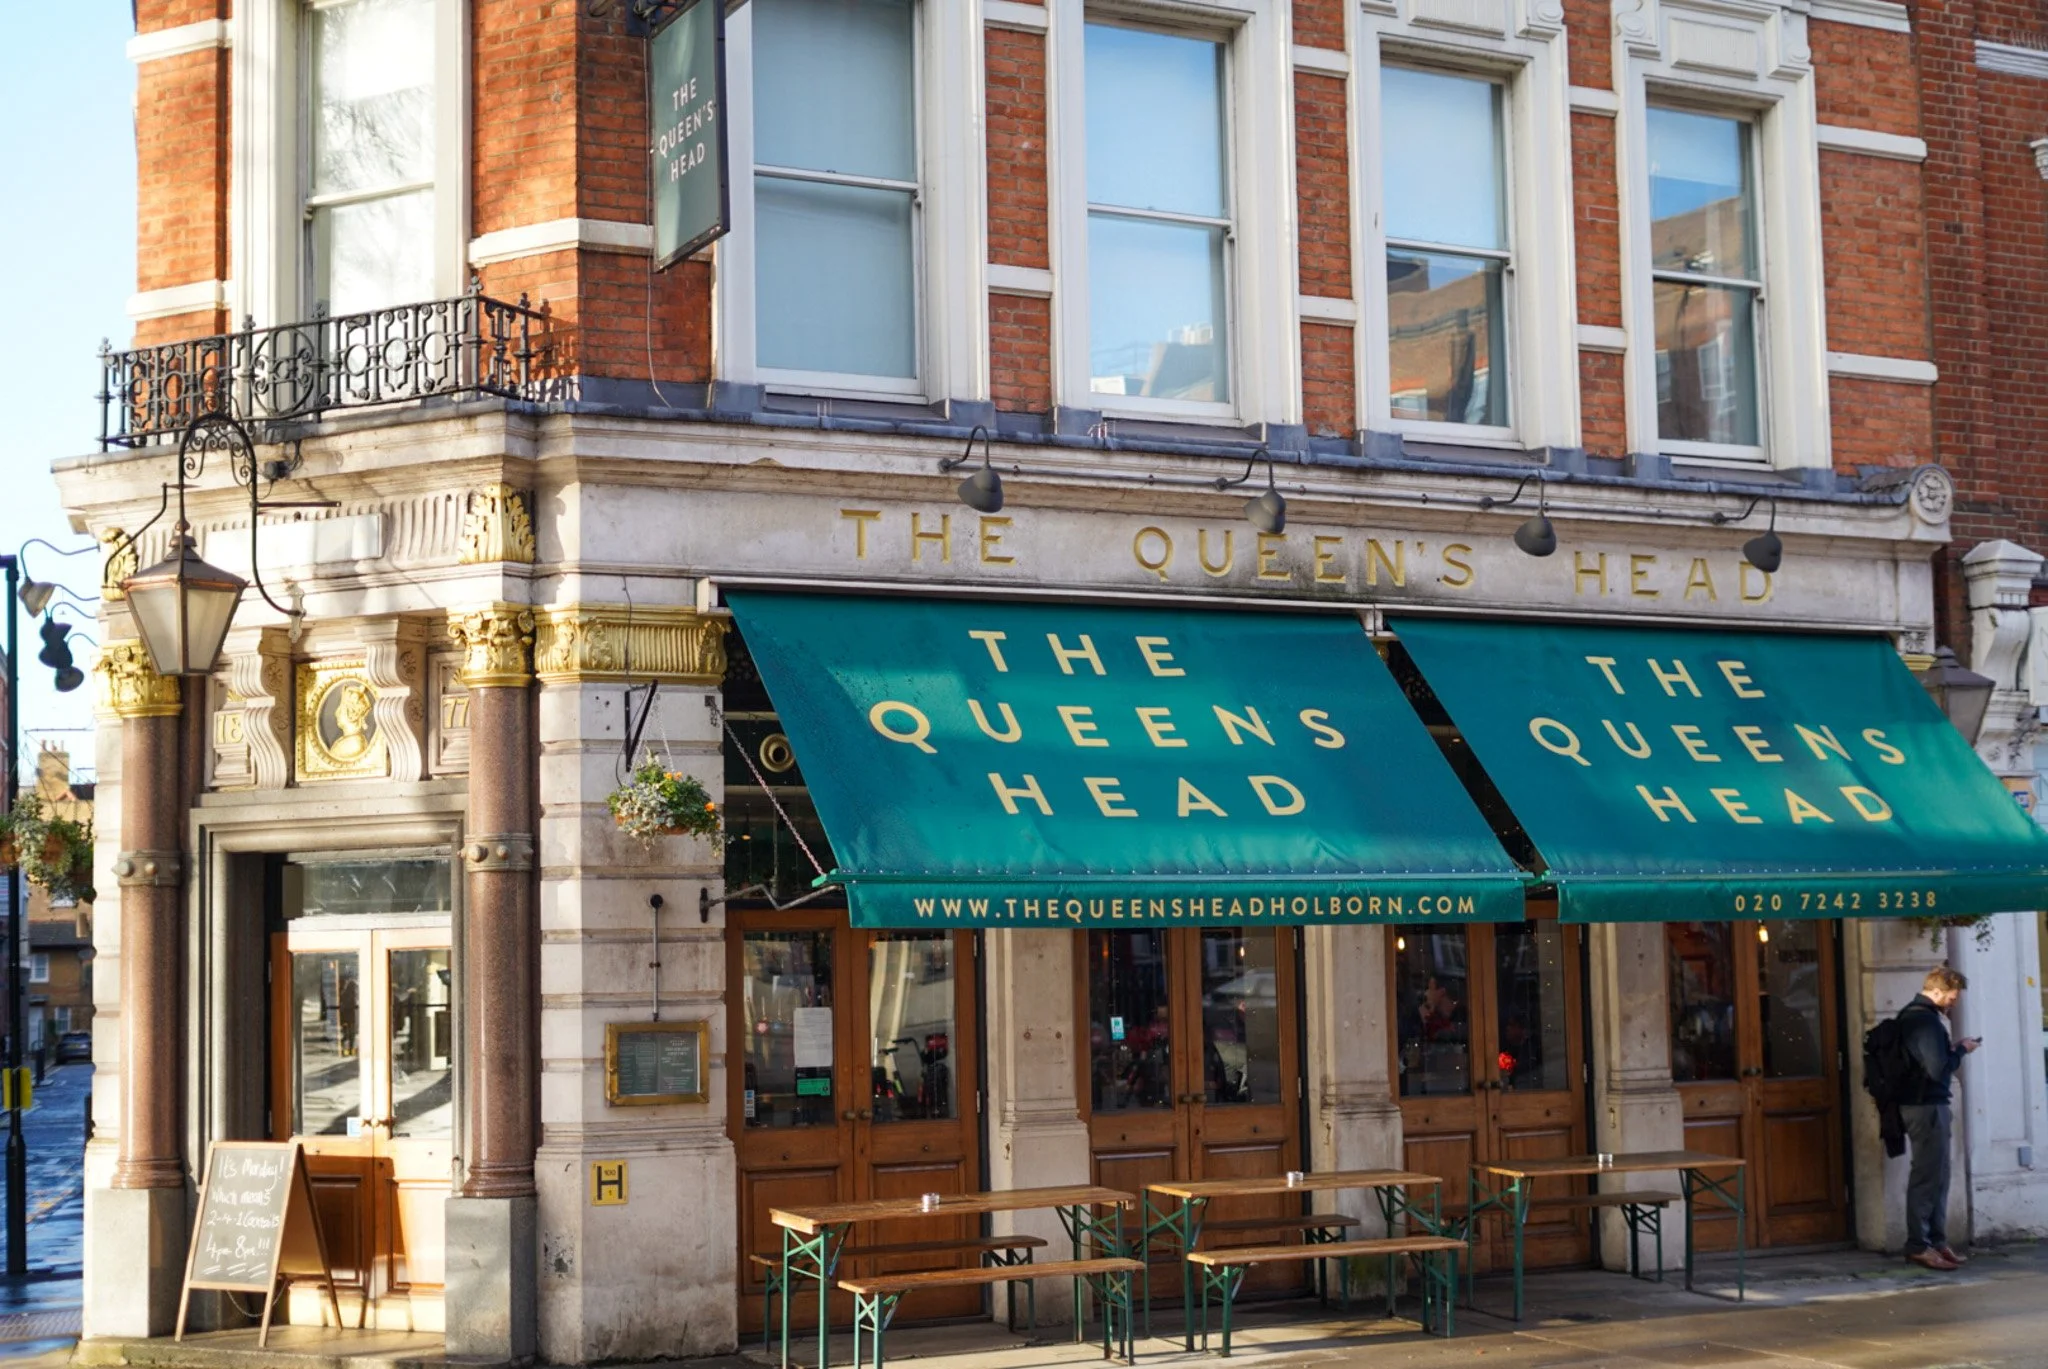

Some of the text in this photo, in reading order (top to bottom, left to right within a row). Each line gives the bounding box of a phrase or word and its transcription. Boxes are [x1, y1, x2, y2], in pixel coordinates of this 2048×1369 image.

[673, 78, 697, 111] THE
[660, 100, 714, 158] QUEEN'S
[671, 142, 705, 182] HEAD
[840, 508, 1772, 605] THE QUEEN'S HEAD
[969, 630, 1186, 677] THE
[1585, 656, 1766, 698] THE
[869, 700, 1346, 754] QUEENS
[1529, 717, 1906, 767] QUEENS
[987, 773, 1306, 817] HEAD
[1635, 785, 1893, 824] HEAD
[914, 896, 1475, 923] WWW.THEQUEENSHEADHOLBORN.COM
[1735, 891, 1937, 911] 020 7242 3238
[597, 1164, 623, 1201] H
